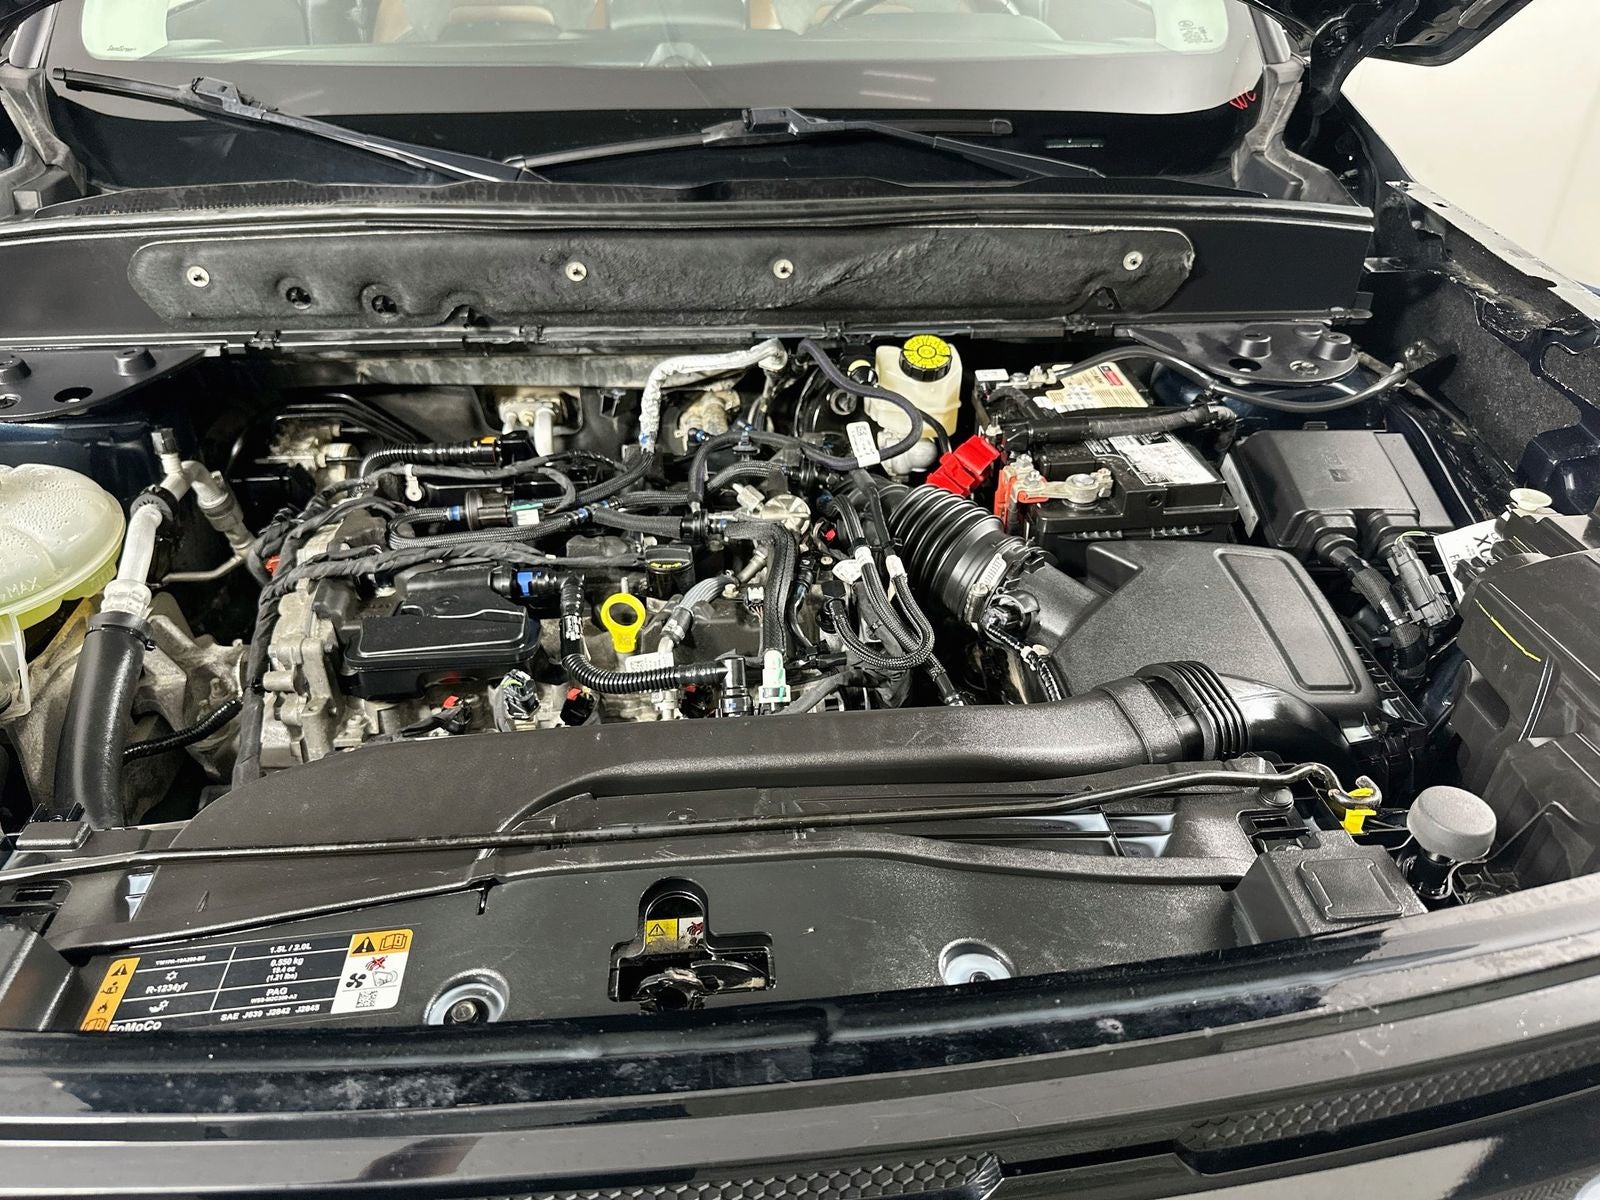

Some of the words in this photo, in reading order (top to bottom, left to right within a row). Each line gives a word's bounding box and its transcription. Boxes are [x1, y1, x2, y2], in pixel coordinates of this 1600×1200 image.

[270, 945, 288, 954] 1.5L
[293, 943, 312, 952] 2.0L
[292, 957, 304, 966] kg
[145, 982, 188, 994] R-1234yf
[266, 987, 288, 996] PAG
[220, 1012, 240, 1021] SAE
